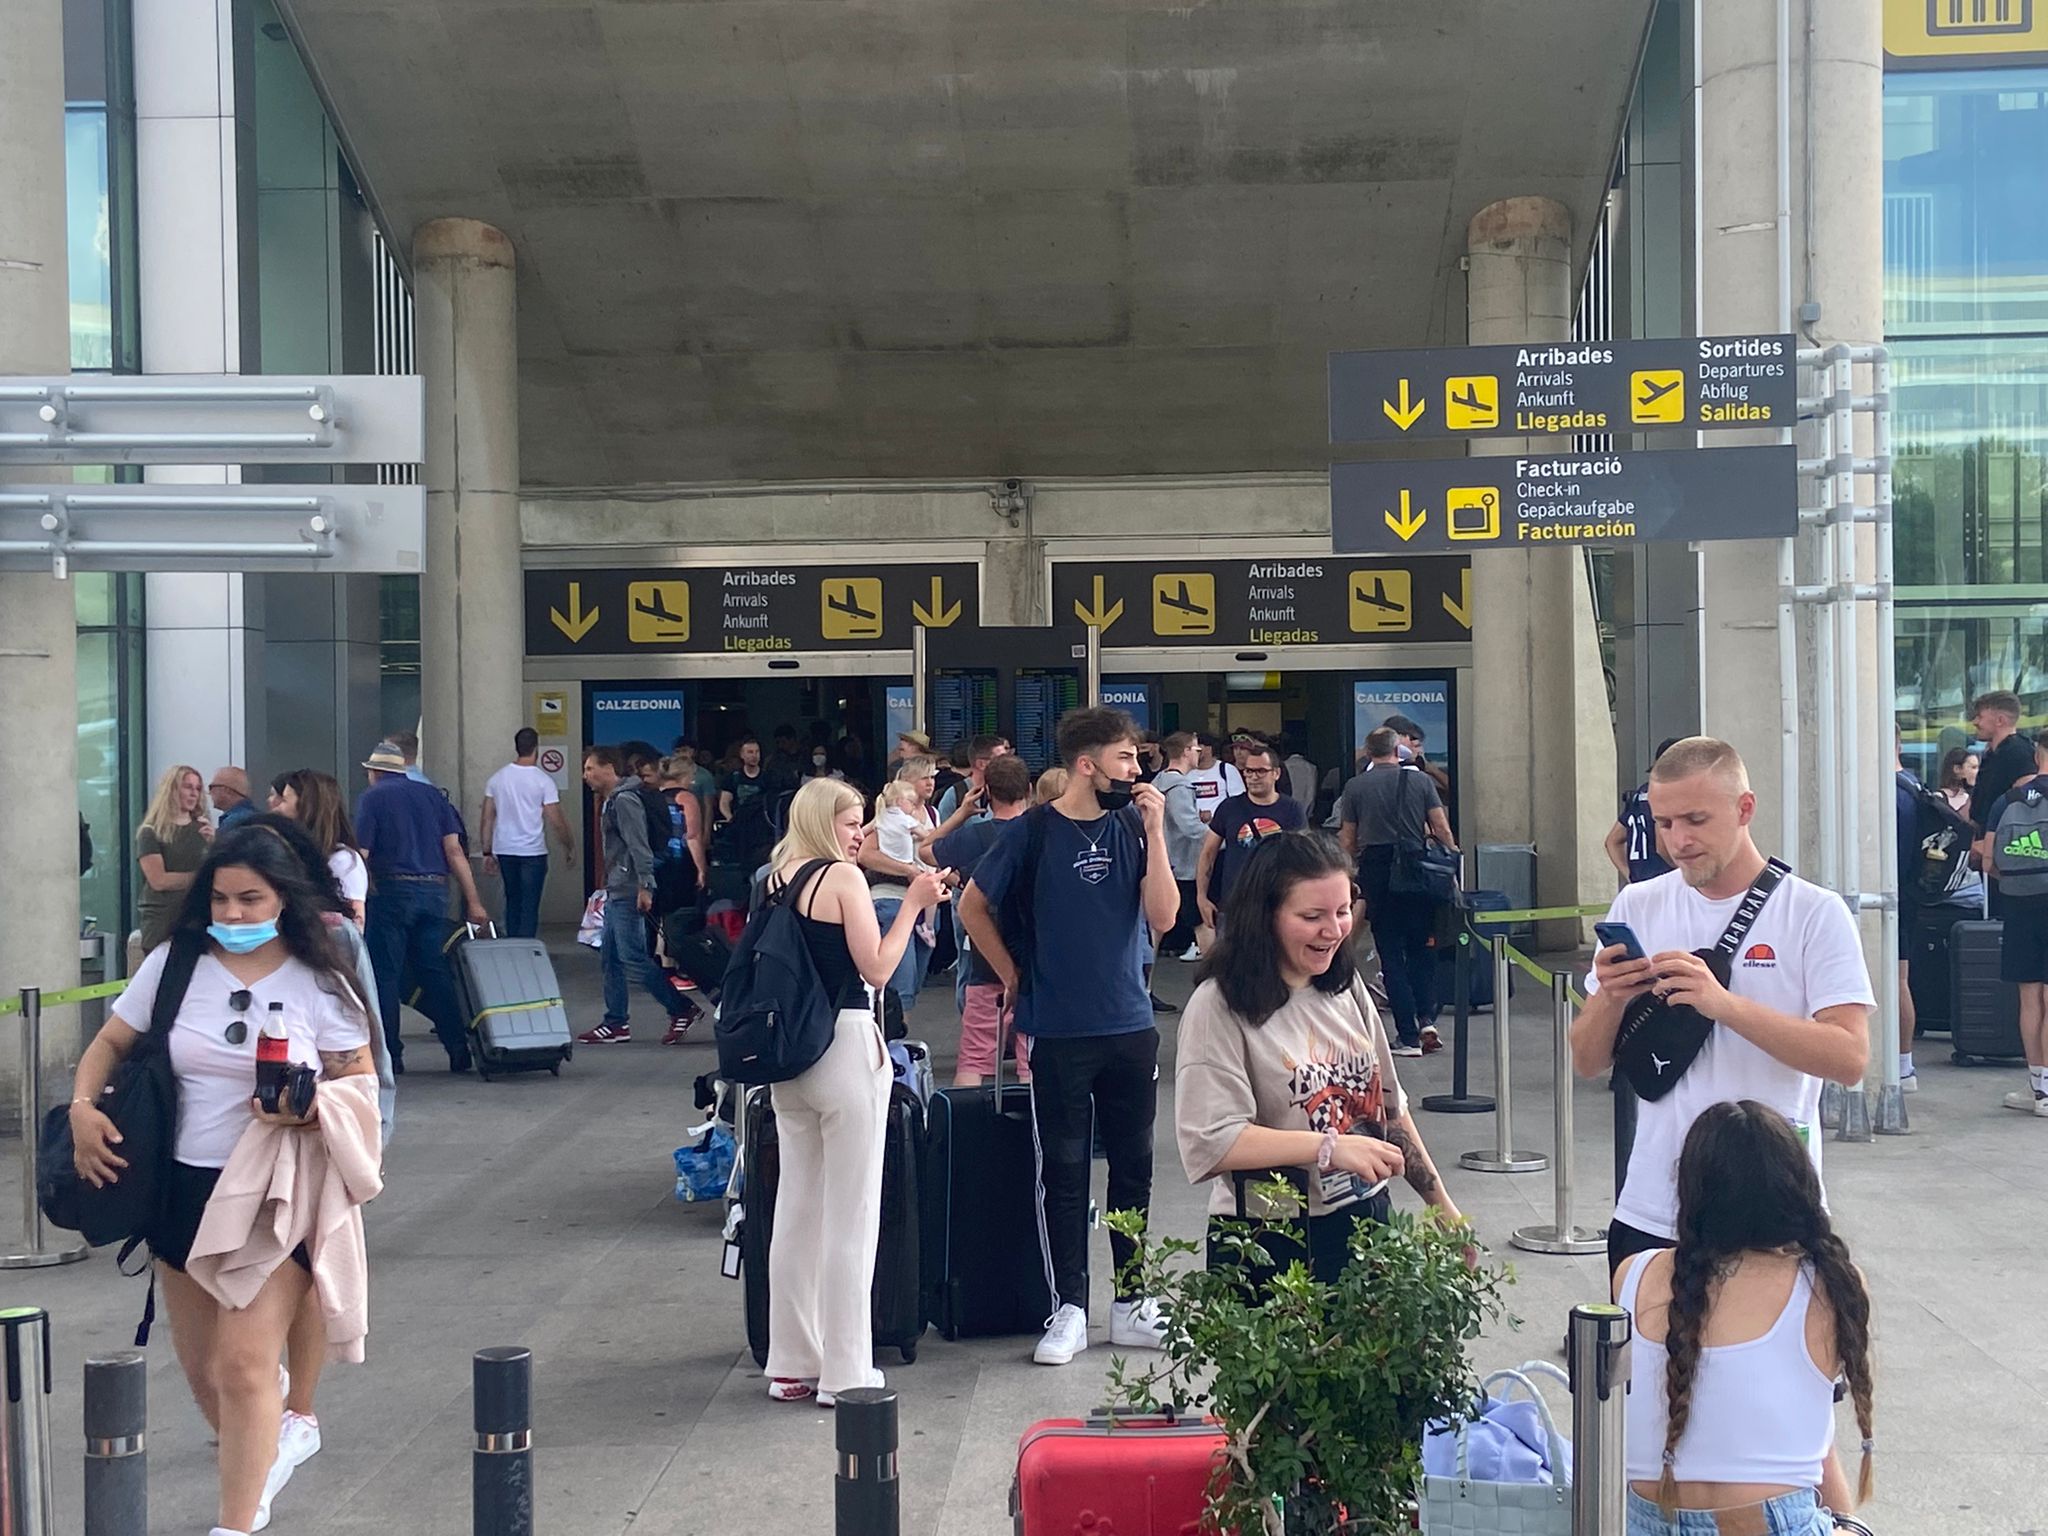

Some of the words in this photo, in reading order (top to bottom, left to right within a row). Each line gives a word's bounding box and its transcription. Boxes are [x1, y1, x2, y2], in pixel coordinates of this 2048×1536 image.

[1516, 346, 1613, 367] Arribades
[1699, 338, 1783, 359] Sortides
[1516, 370, 1573, 387] Arrivals
[1699, 362, 1784, 381] Departures
[1517, 390, 1575, 407] Ankunft
[1700, 382, 1749, 401] Abflug
[1516, 410, 1607, 432] Llegadas
[1700, 402, 1771, 422] Salidas
[1516, 456, 1623, 478] Facturació
[1516, 481, 1581, 498] Check-in
[1517, 499, 1636, 520] Gepäckaufgabe
[1518, 519, 1636, 540] Facturación
[722, 570, 797, 586] Arribades
[1248, 562, 1324, 578] Arribades
[722, 592, 769, 607] Arrivals
[1248, 584, 1295, 600] Arrivals
[722, 613, 769, 629] Ankunft
[1248, 606, 1296, 621] Ankunft
[724, 634, 793, 653] Llegadas
[1249, 627, 1320, 646] Llegadas
[596, 699, 682, 711] CALZEDONIA
[1356, 692, 1445, 704] CALZEDONIA
[1627, 814, 1648, 861] 21
[1718, 886, 1769, 954] JORDAN
[1742, 960, 1777, 969] ellesse
